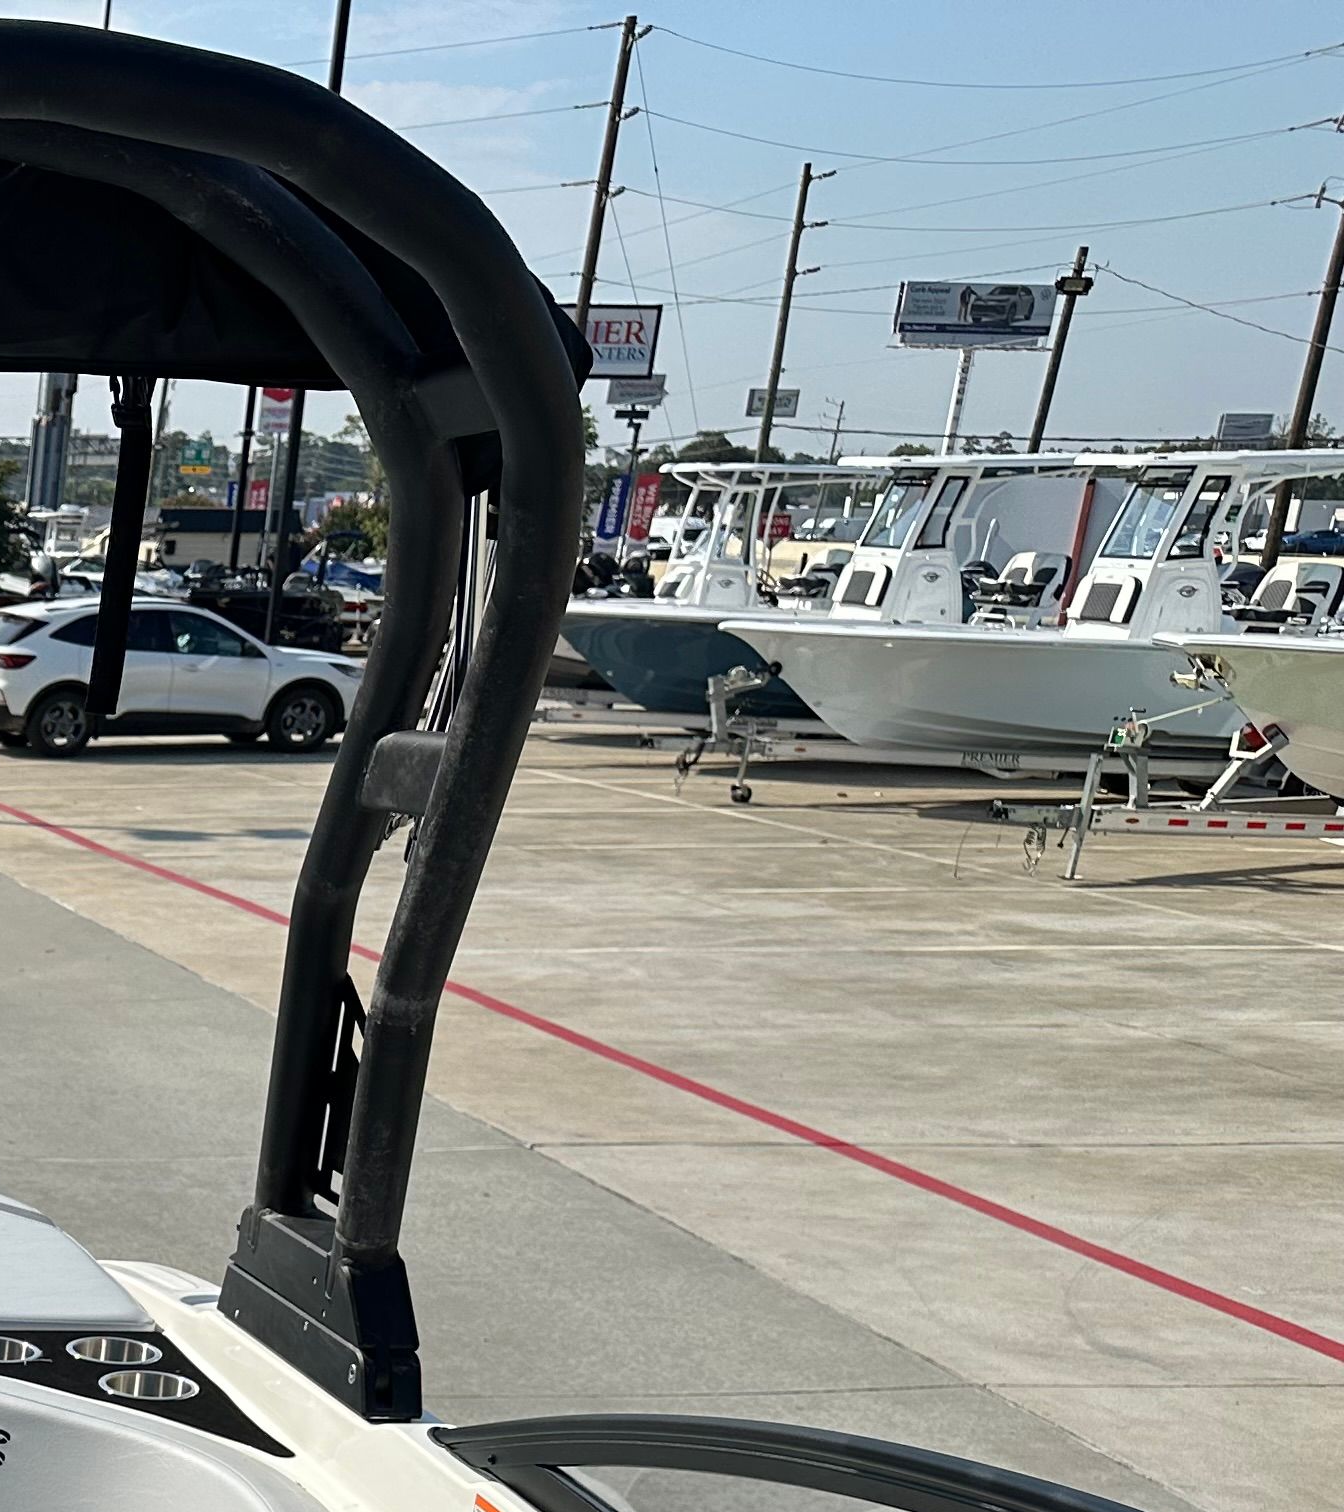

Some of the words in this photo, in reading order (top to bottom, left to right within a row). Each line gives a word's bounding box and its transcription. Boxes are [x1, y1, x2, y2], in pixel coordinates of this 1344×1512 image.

[591, 320, 646, 345] IER
[593, 346, 646, 361] NTERS
[961, 751, 1022, 764] PREMIER
